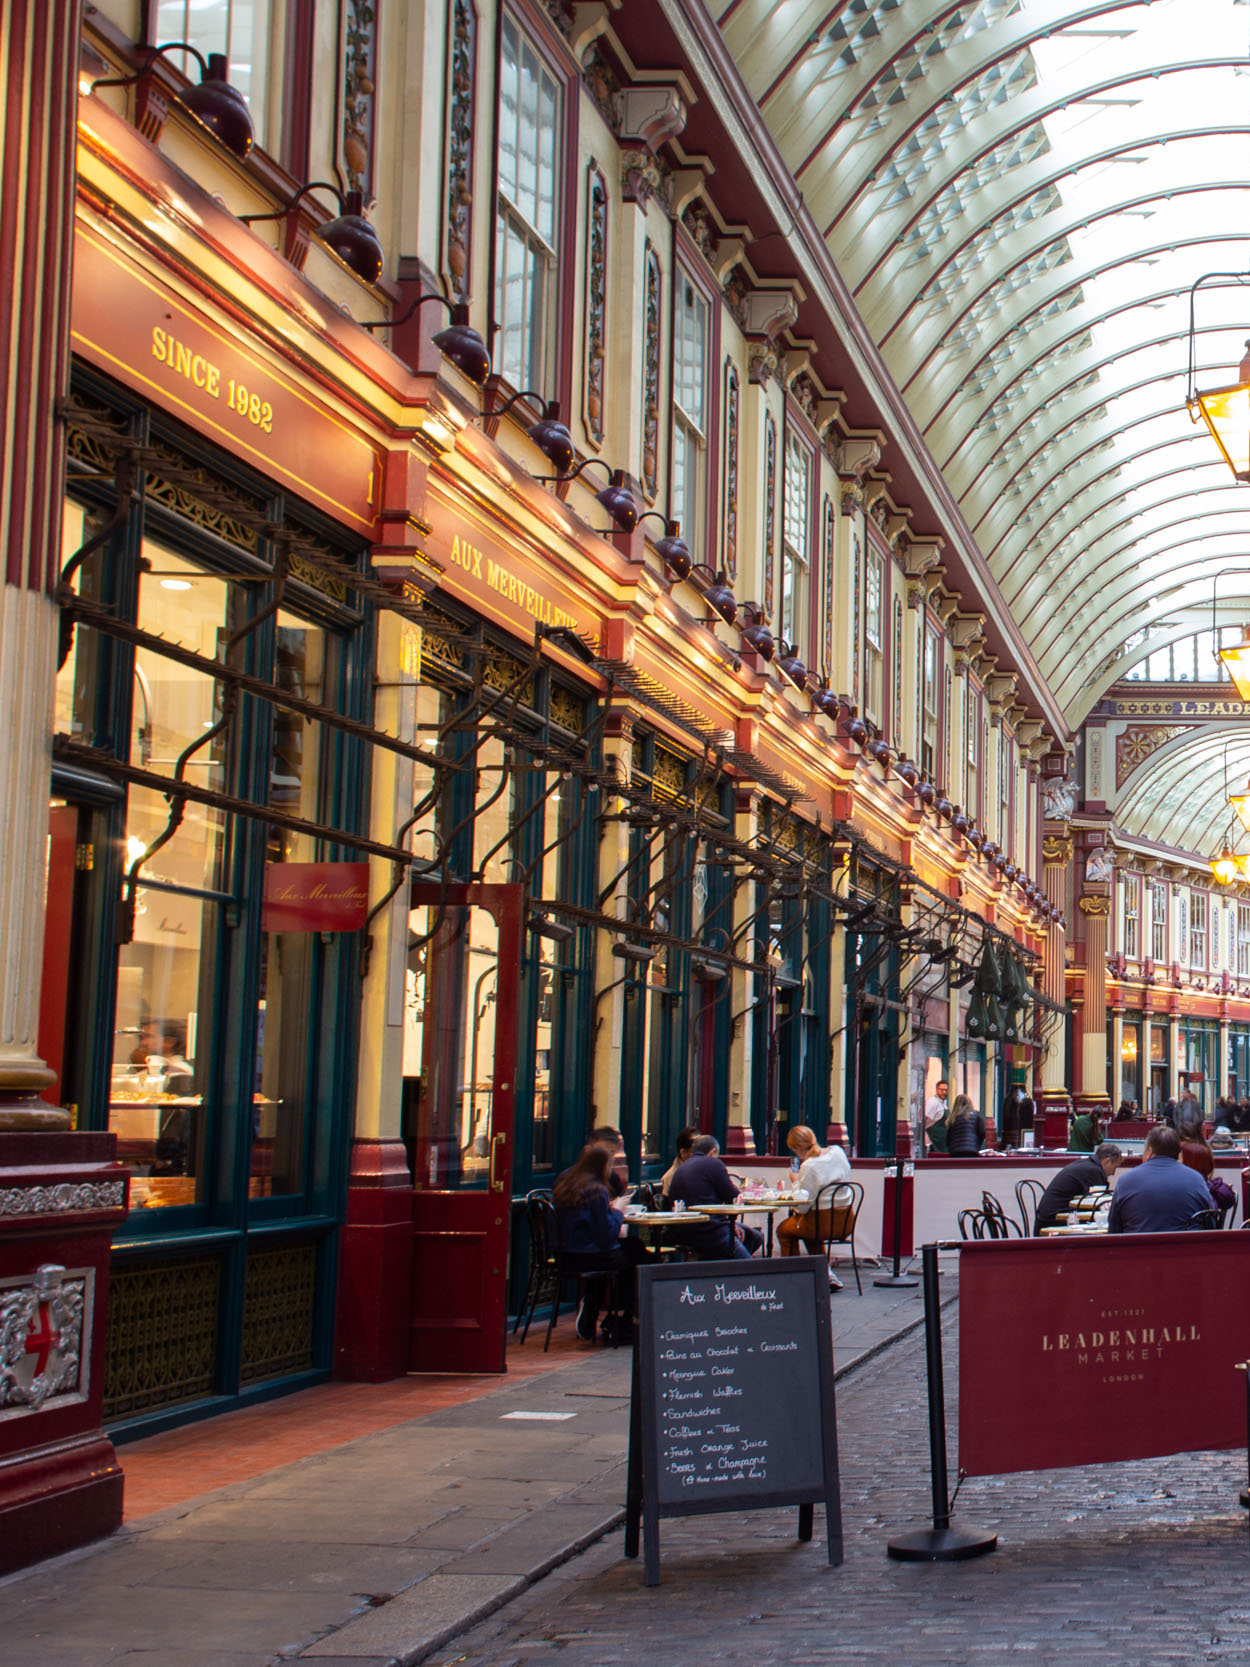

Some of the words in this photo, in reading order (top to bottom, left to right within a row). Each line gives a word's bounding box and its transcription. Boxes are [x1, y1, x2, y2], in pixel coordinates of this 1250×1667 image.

[152, 326, 220, 398] SINCE
[227, 379, 273, 433] 1982
[450, 535, 484, 580] AUX
[680, 1284, 706, 1305] Aux
[714, 1283, 777, 1305] Merveilleux
[1042, 1324, 1201, 1351] LEADENHALL
[1077, 1347, 1164, 1365] MARKET
[712, 1385, 744, 1398] Waffles
[667, 1406, 722, 1420] Sandwiches
[700, 1443, 735, 1455] Orange
[740, 1439, 769, 1451] Juice
[718, 1455, 768, 1471] Champagne
